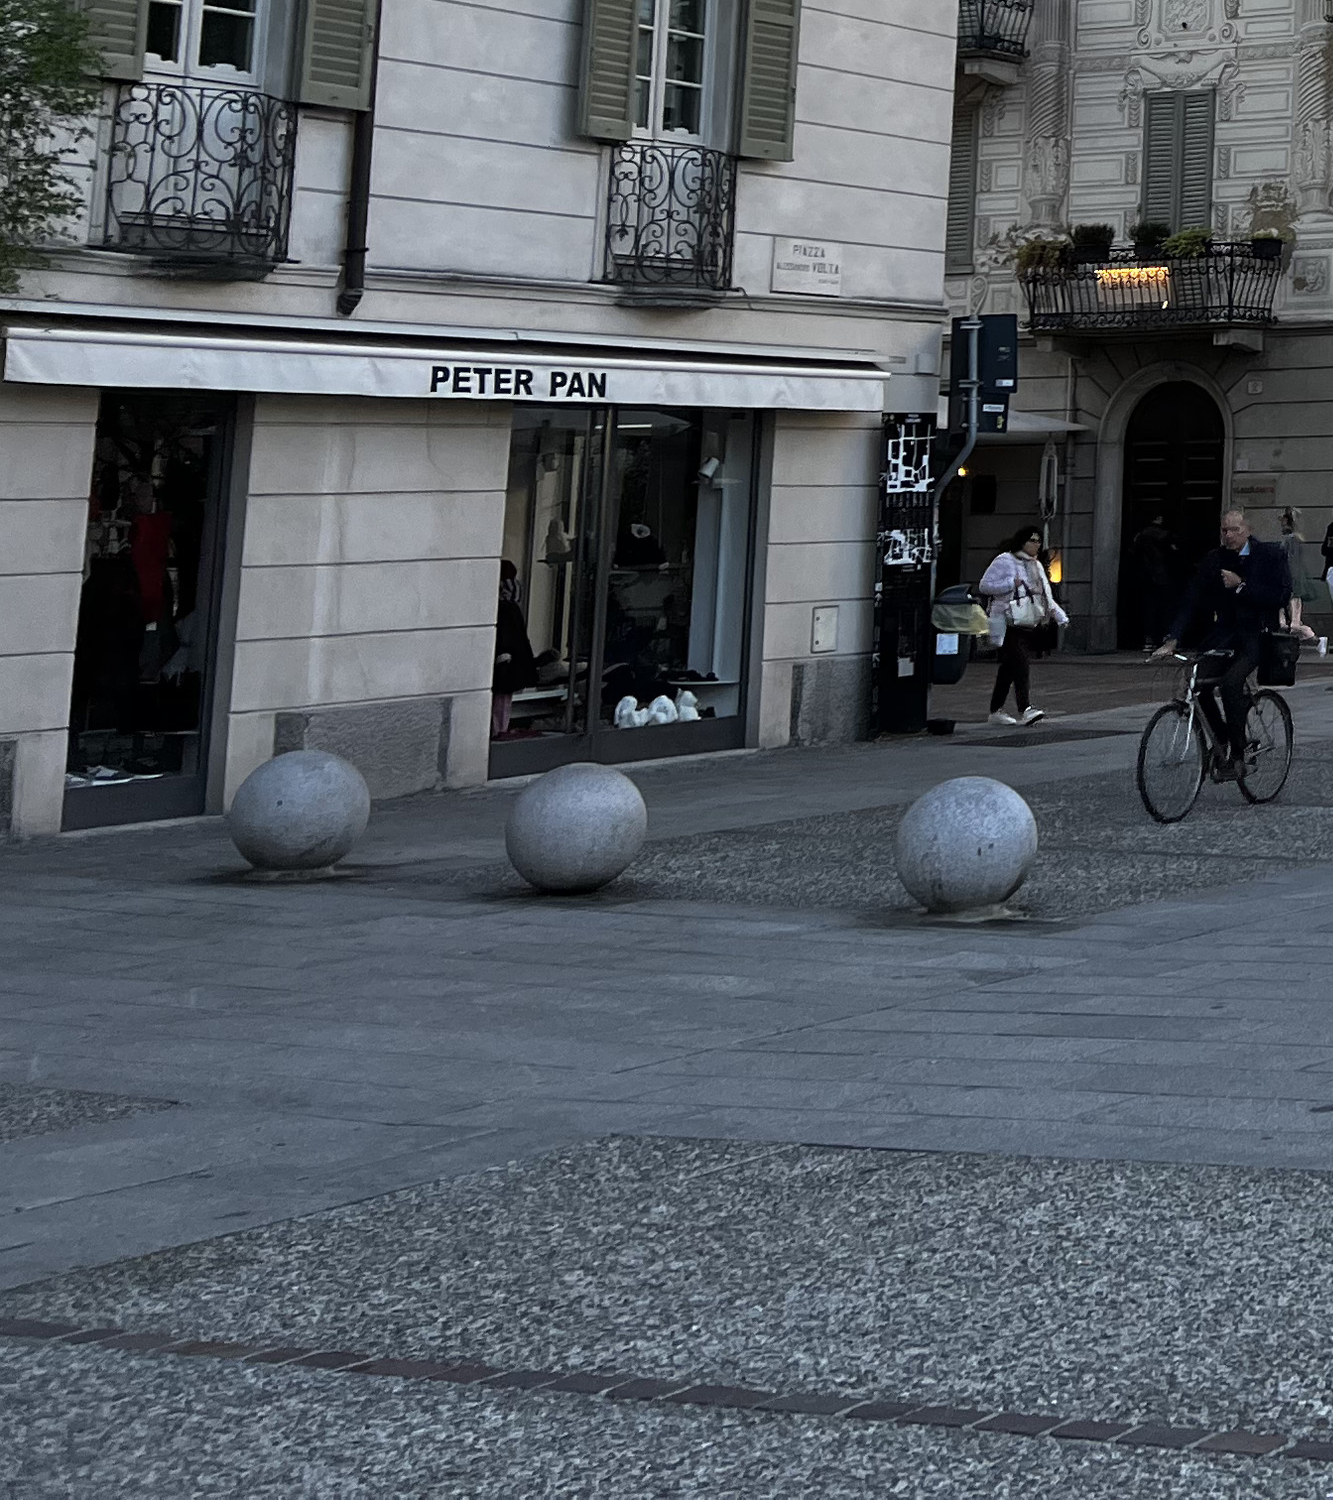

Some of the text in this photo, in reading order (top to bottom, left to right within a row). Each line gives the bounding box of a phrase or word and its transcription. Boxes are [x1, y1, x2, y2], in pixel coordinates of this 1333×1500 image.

[792, 244, 826, 258] PIAZZA
[812, 262, 839, 275] VOLTA
[430, 366, 607, 398] PETER PAN
